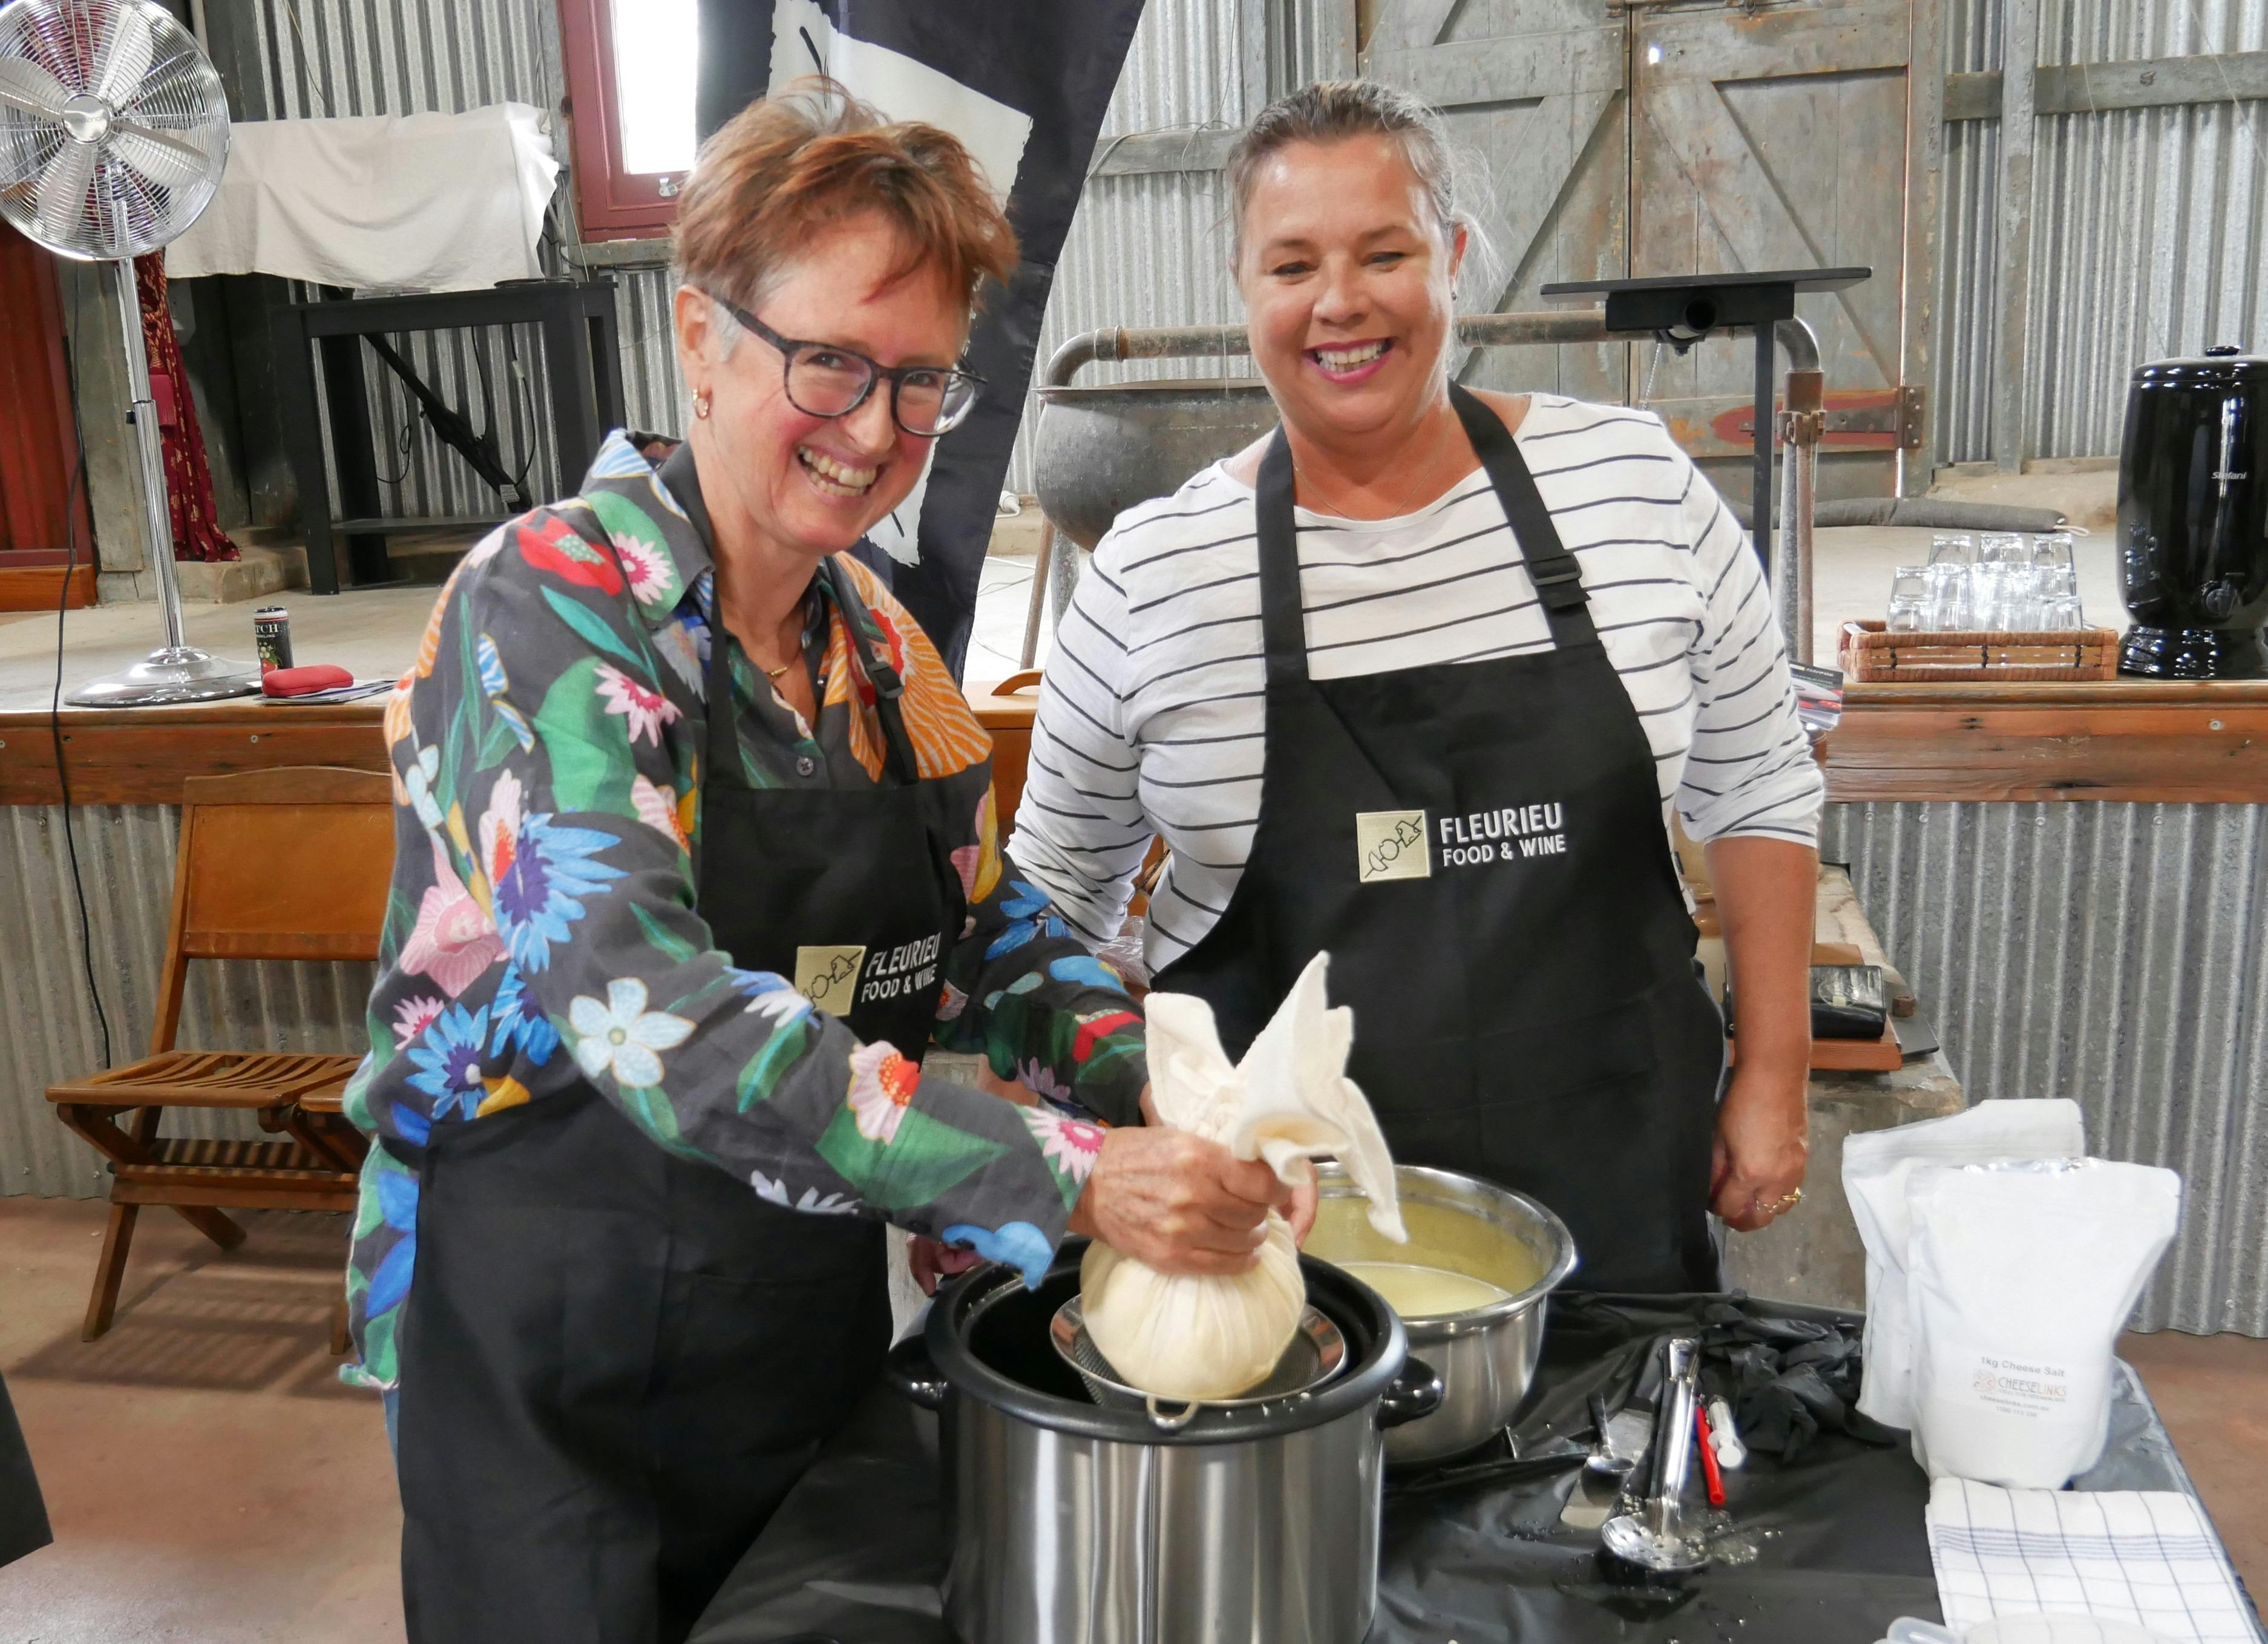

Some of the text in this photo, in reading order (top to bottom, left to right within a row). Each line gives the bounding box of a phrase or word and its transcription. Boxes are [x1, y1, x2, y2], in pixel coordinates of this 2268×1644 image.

[1440, 802, 1563, 844] FLEURIEU
[1443, 834, 1567, 867] FOOD & WINE
[865, 931, 942, 978] FLEURIEU
[861, 963, 937, 1003] FOOD & WINE
[1980, 1356, 2065, 1377] 1kg Cheese Salt
[1998, 1377, 2067, 1397] CHEESELINKS
